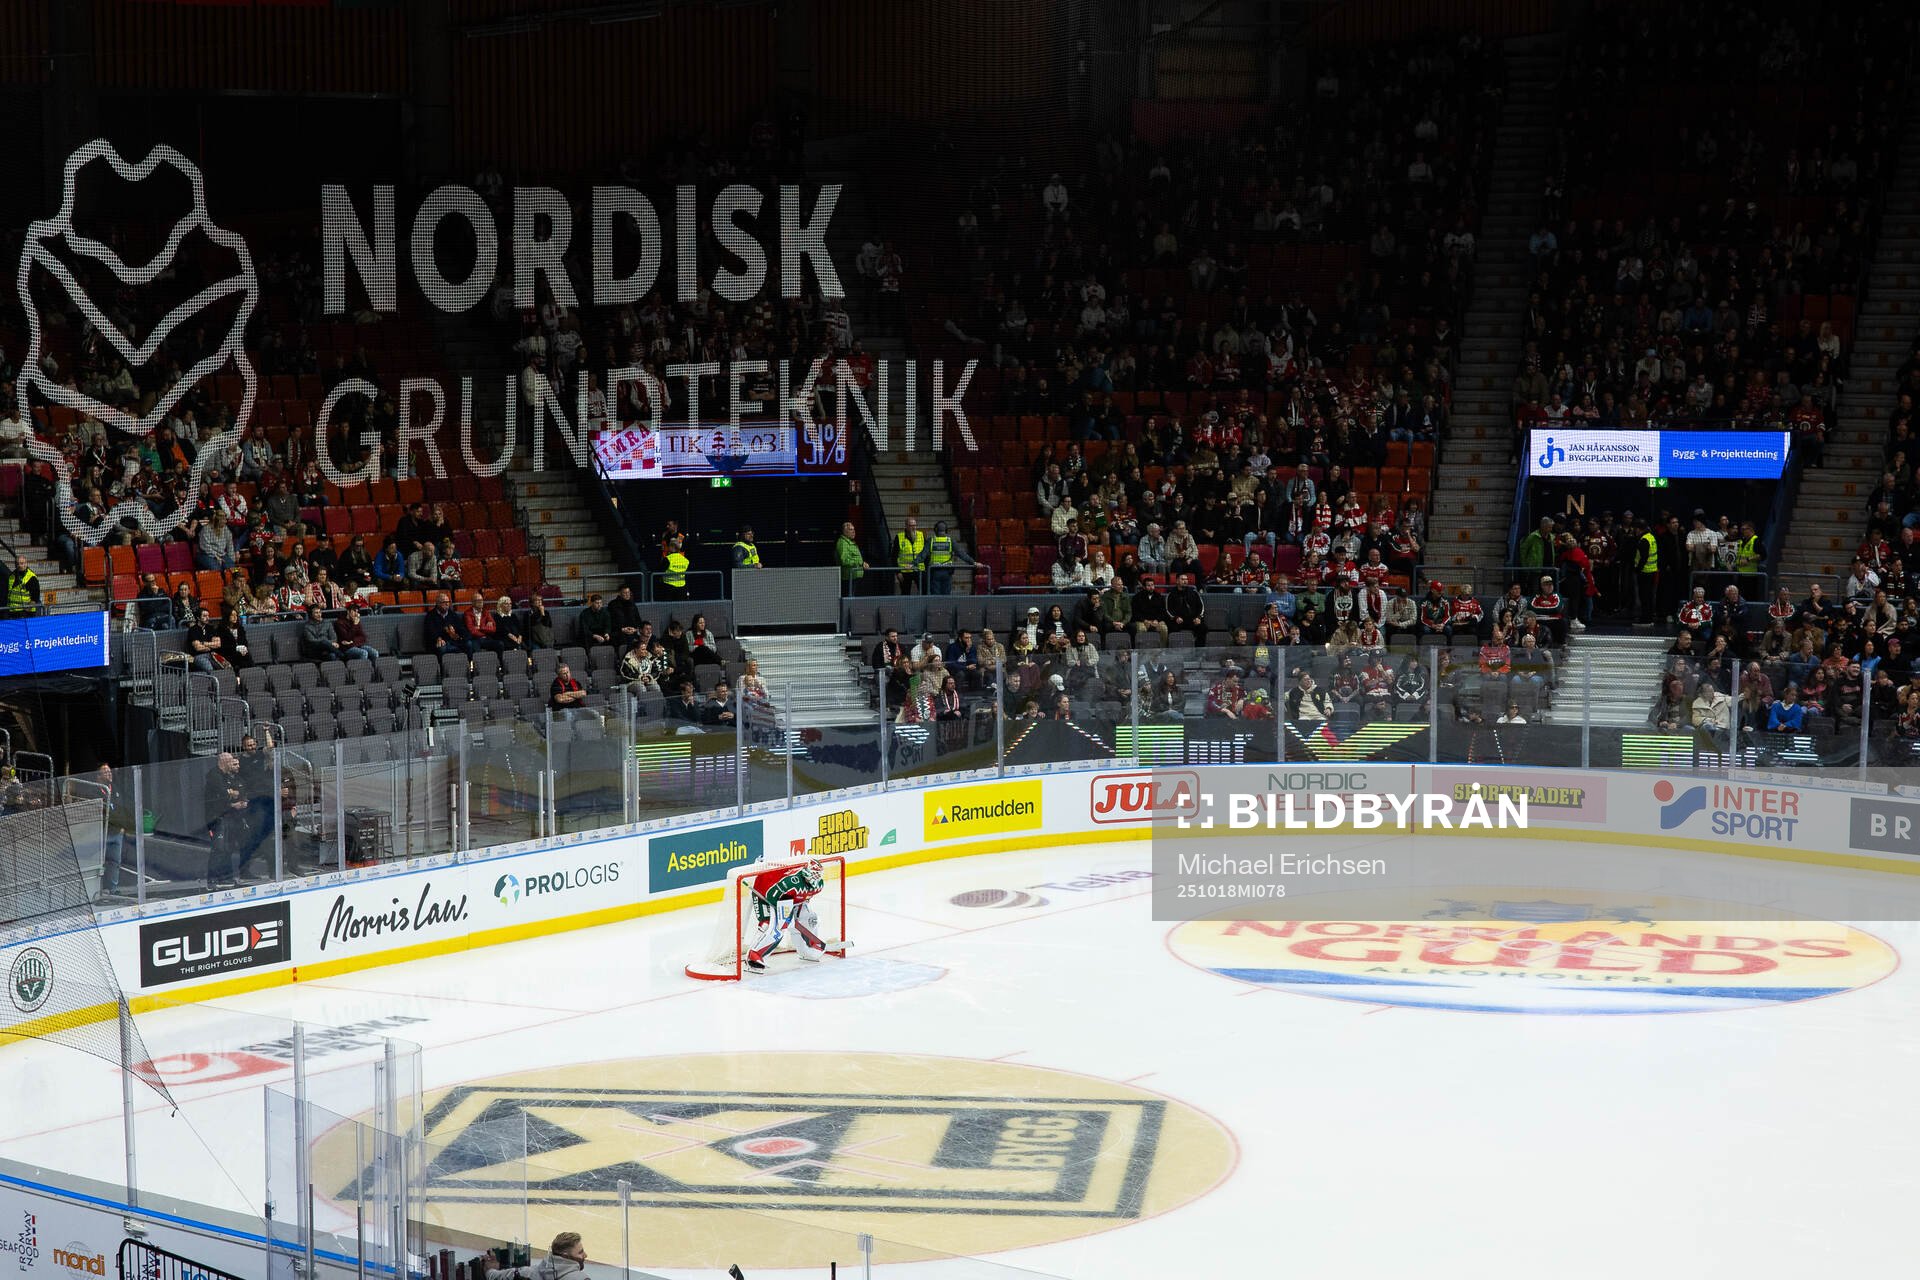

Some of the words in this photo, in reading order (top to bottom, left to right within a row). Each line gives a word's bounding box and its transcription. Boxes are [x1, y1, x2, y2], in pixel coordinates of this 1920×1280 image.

[321, 184, 845, 315] NORDISK
[315, 357, 979, 488] GRUNDTEKNIK
[1568, 443, 1585, 452] JAN
[1587, 441, 1640, 453] HÅKANSSON
[1568, 454, 1640, 463] BYGGPLANERING
[1641, 455, 1654, 463] AB
[1672, 449, 1699, 460] Bygg-
[1701, 449, 1709, 459] &
[1710, 449, 1779, 461] Projektledning
[1566, 494, 1585, 515] N
[25, 639, 32, 649] &
[34, 633, 98, 650] Projektledning
[1095, 780, 1195, 813] JULA
[1268, 773, 1367, 790] NORDIC
[951, 800, 1034, 823] Ramudden
[1713, 784, 1799, 816] INTER
[818, 810, 854, 836] EURO
[1711, 811, 1799, 842] SPORT
[808, 826, 867, 855] JACKPOT
[667, 842, 748, 873] Assemblin
[525, 862, 620, 897] PROLOGIS
[320, 895, 410, 951] Morris
[152, 920, 278, 967] GUIDE
[1222, 920, 1853, 958] NORRLANDS
[180, 967, 195, 975] THE
[197, 962, 221, 972] RIGHT
[223, 955, 253, 968] GLOVES
[1287, 937, 1778, 976] GULD
[1363, 966, 1675, 984] ALKOHOLFRI
[991, 1116, 1080, 1168] BYGG
[25, 1210, 34, 1267] NORWAY
[53, 1248, 105, 1277] mondi
